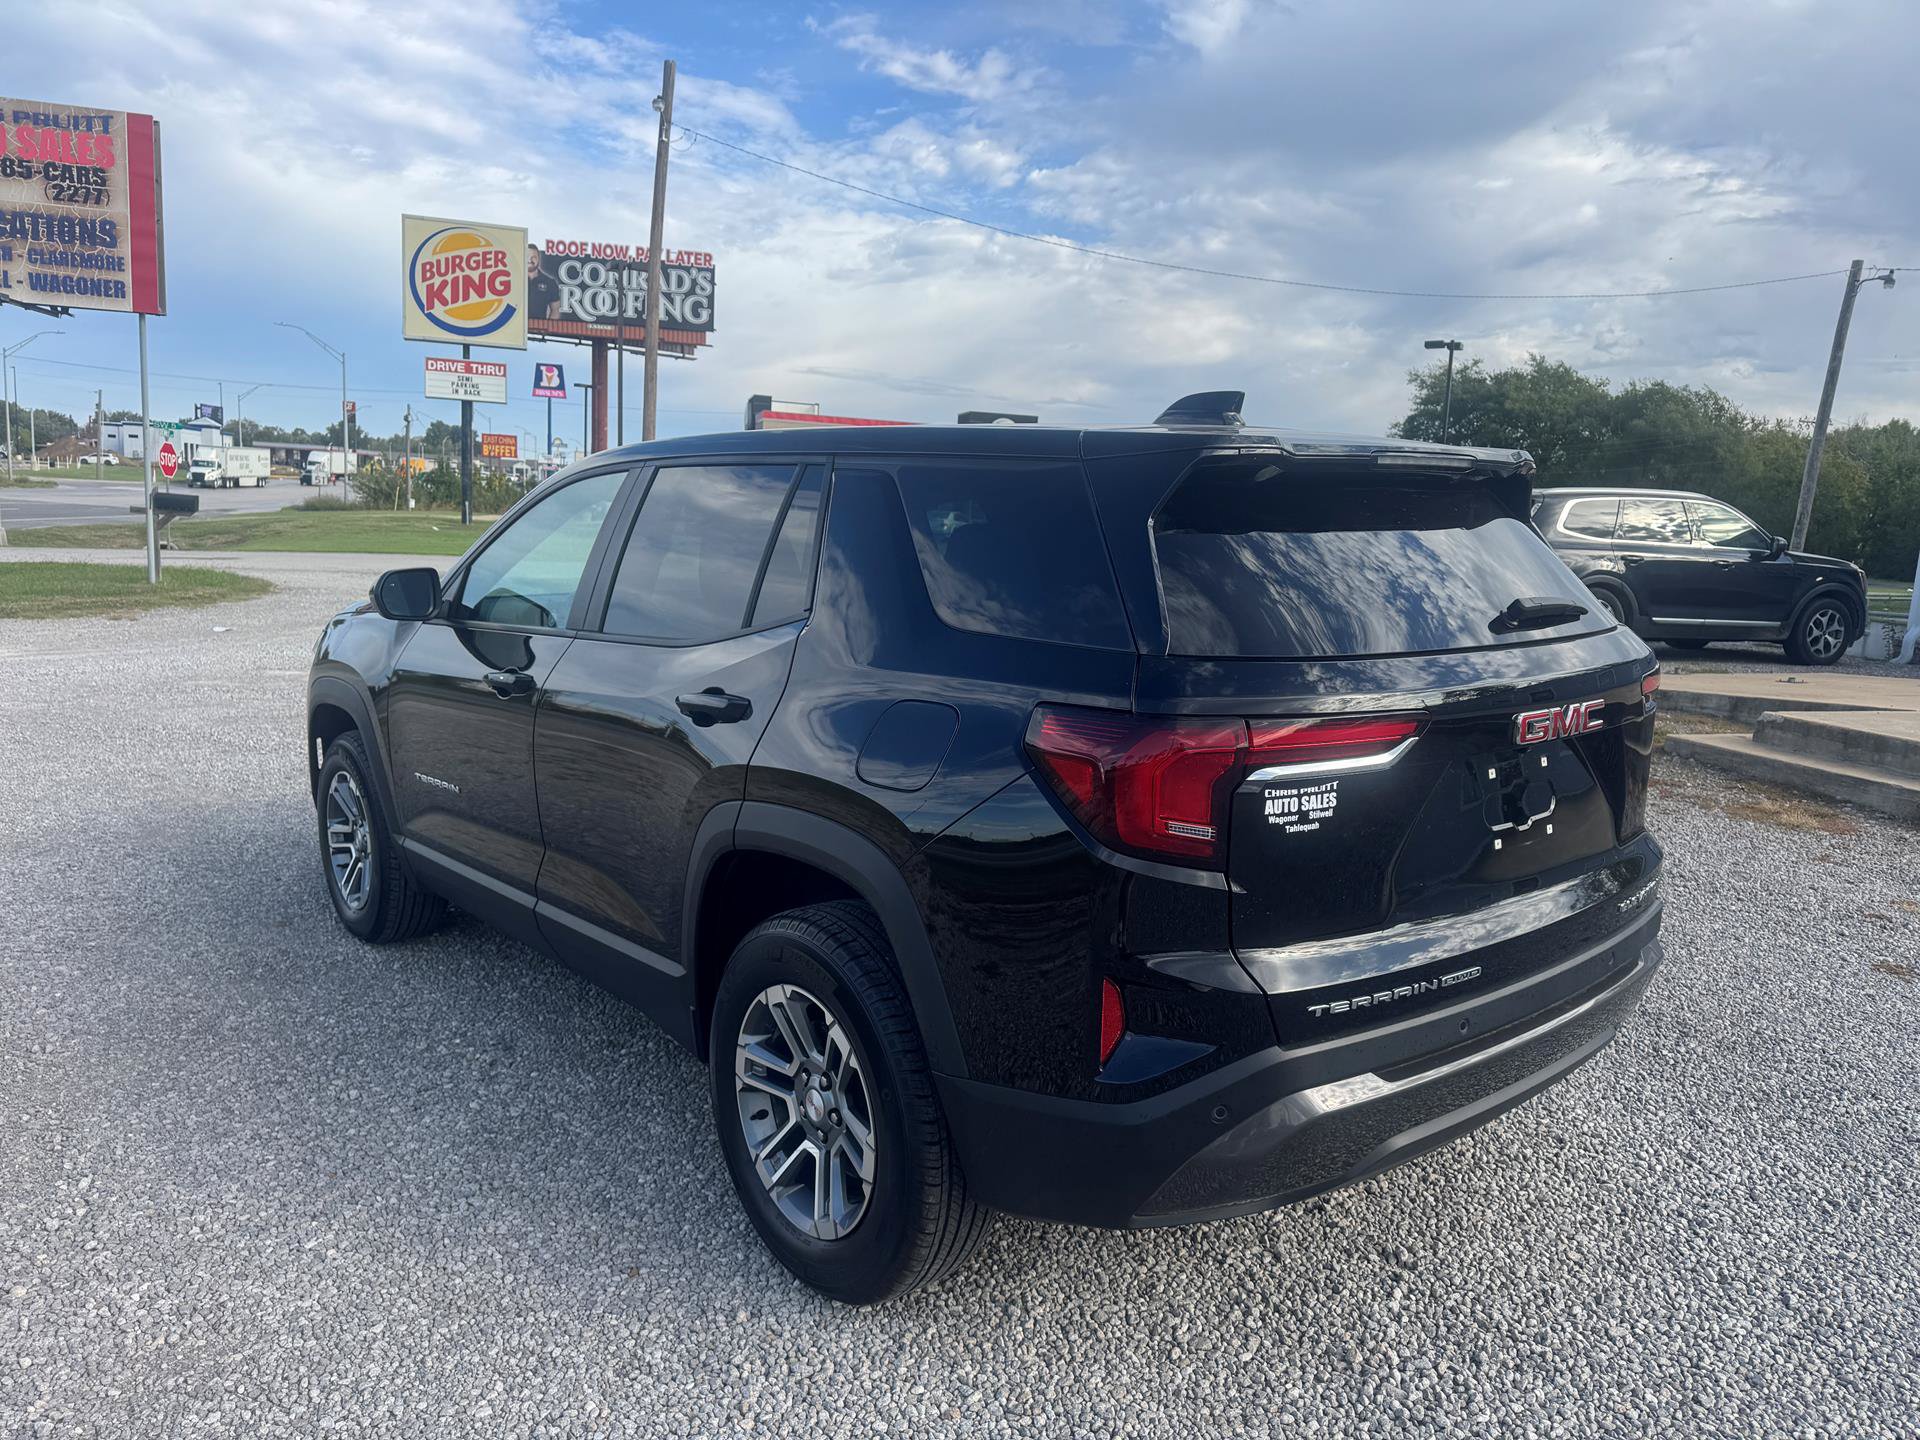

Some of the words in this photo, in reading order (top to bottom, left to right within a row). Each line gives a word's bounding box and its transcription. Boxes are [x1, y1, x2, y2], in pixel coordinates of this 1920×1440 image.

[12, 110, 114, 135] PRUITT
[15, 124, 115, 170] SALES
[44, 181, 110, 208] (2277)
[27, 248, 125, 272] CLAREMORE
[545, 239, 590, 257] ROOF
[591, 243, 633, 263] NOW,
[665, 250, 713, 268] LATER
[421, 251, 508, 283] BURGER
[28, 272, 126, 299] WAGONER
[425, 270, 512, 312] KING
[427, 360, 465, 373] DRIVE
[470, 364, 504, 376] THRU
[457, 375, 473, 383] SEMI
[451, 381, 480, 389] PARKING
[160, 452, 177, 468] STOP
[1512, 698, 1606, 746] GMC
[414, 771, 460, 794] TERRAIN
[1264, 788, 1298, 798] CHRIS
[1300, 780, 1340, 795] PRUITT
[1264, 796, 1299, 816] AUTO
[1301, 791, 1337, 812] SALES
[1268, 814, 1299, 825] Wagoner
[1308, 808, 1334, 820] Stilwell
[1285, 821, 1320, 834] Tahlequah
[1307, 977, 1438, 1018] TERRAIN
